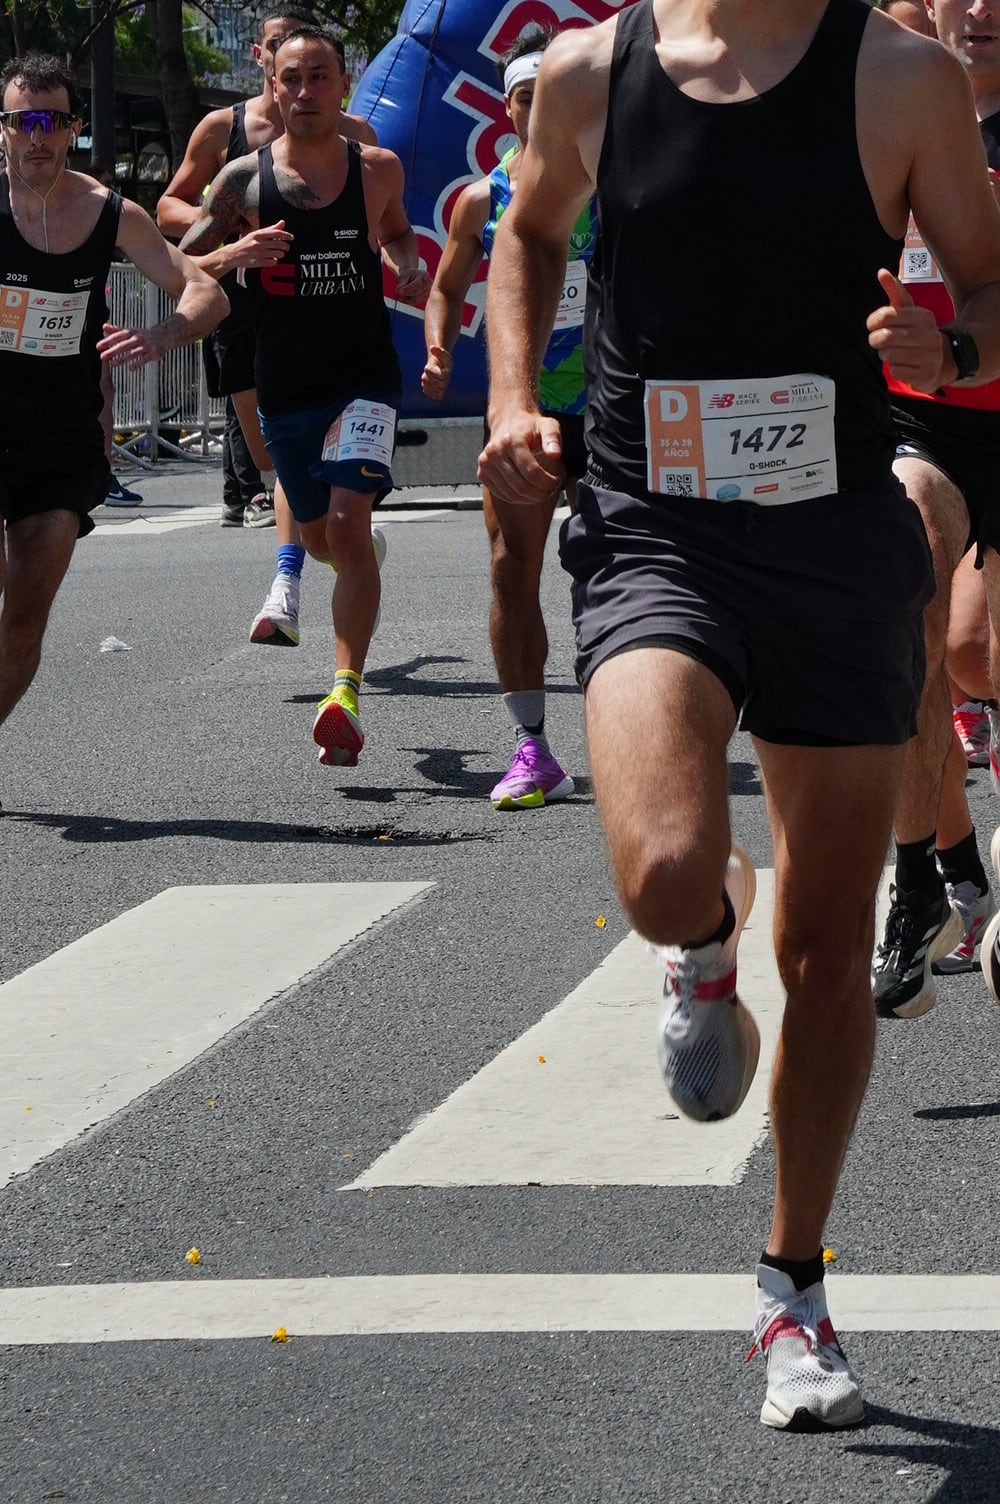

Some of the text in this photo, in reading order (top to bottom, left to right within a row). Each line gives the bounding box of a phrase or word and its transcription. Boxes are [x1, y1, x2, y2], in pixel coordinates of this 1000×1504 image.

[300, 251, 351, 261] new balance
[6, 272, 28, 282] 2025
[300, 261, 358, 278] MILLA
[300, 275, 365, 297] URBANA
[5, 290, 23, 308] D
[39, 315, 73, 330] 1613
[660, 390, 688, 422] D
[736, 398, 760, 406] SERIES
[350, 421, 385, 437] 1441
[729, 423, 808, 456] 1472
[663, 448, 690, 458] AÑOS
[749, 457, 788, 471] G-SHOCK
